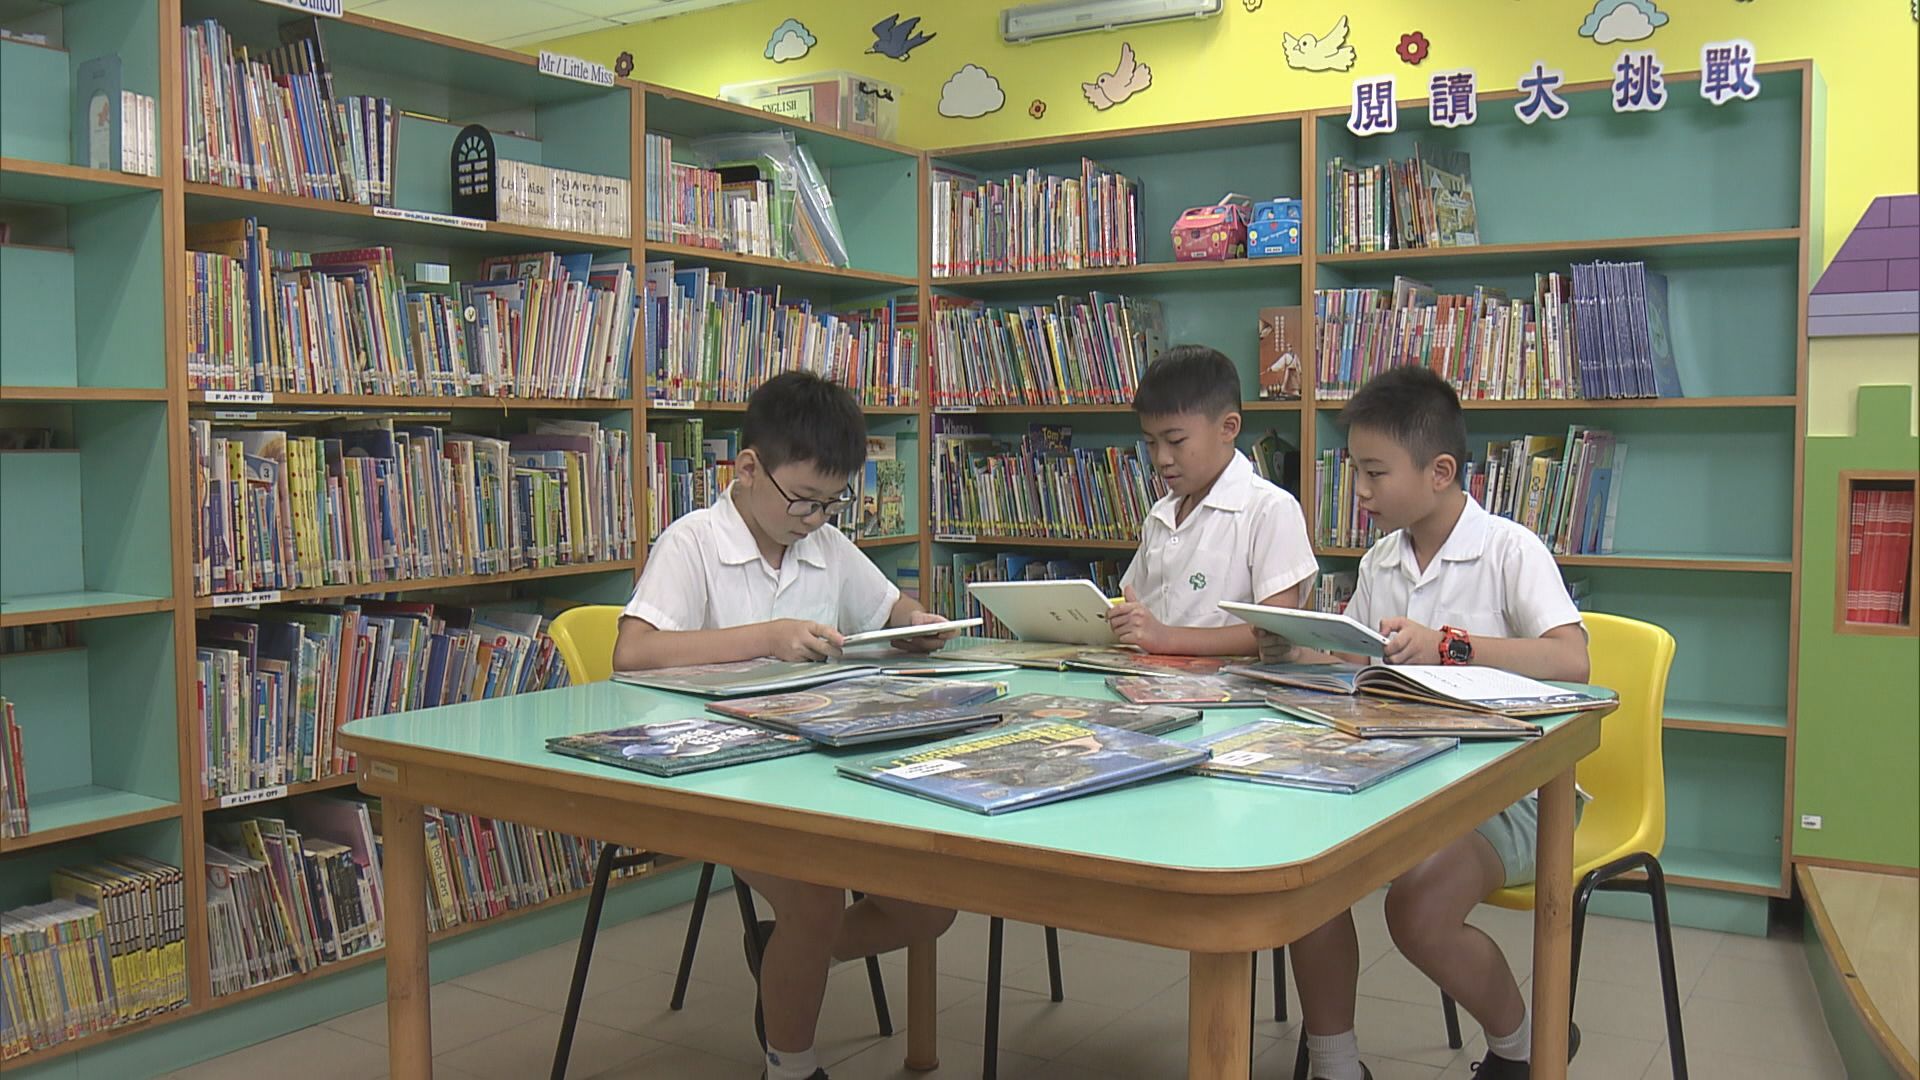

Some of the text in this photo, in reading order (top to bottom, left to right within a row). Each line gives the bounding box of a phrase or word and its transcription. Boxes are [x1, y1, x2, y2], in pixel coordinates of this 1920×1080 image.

[541, 53, 555, 72] Mr
[563, 58, 589, 80] Little
[591, 64, 613, 84] Miss
[762, 100, 797, 113] ENGLISH
[263, 468, 270, 478] 3
